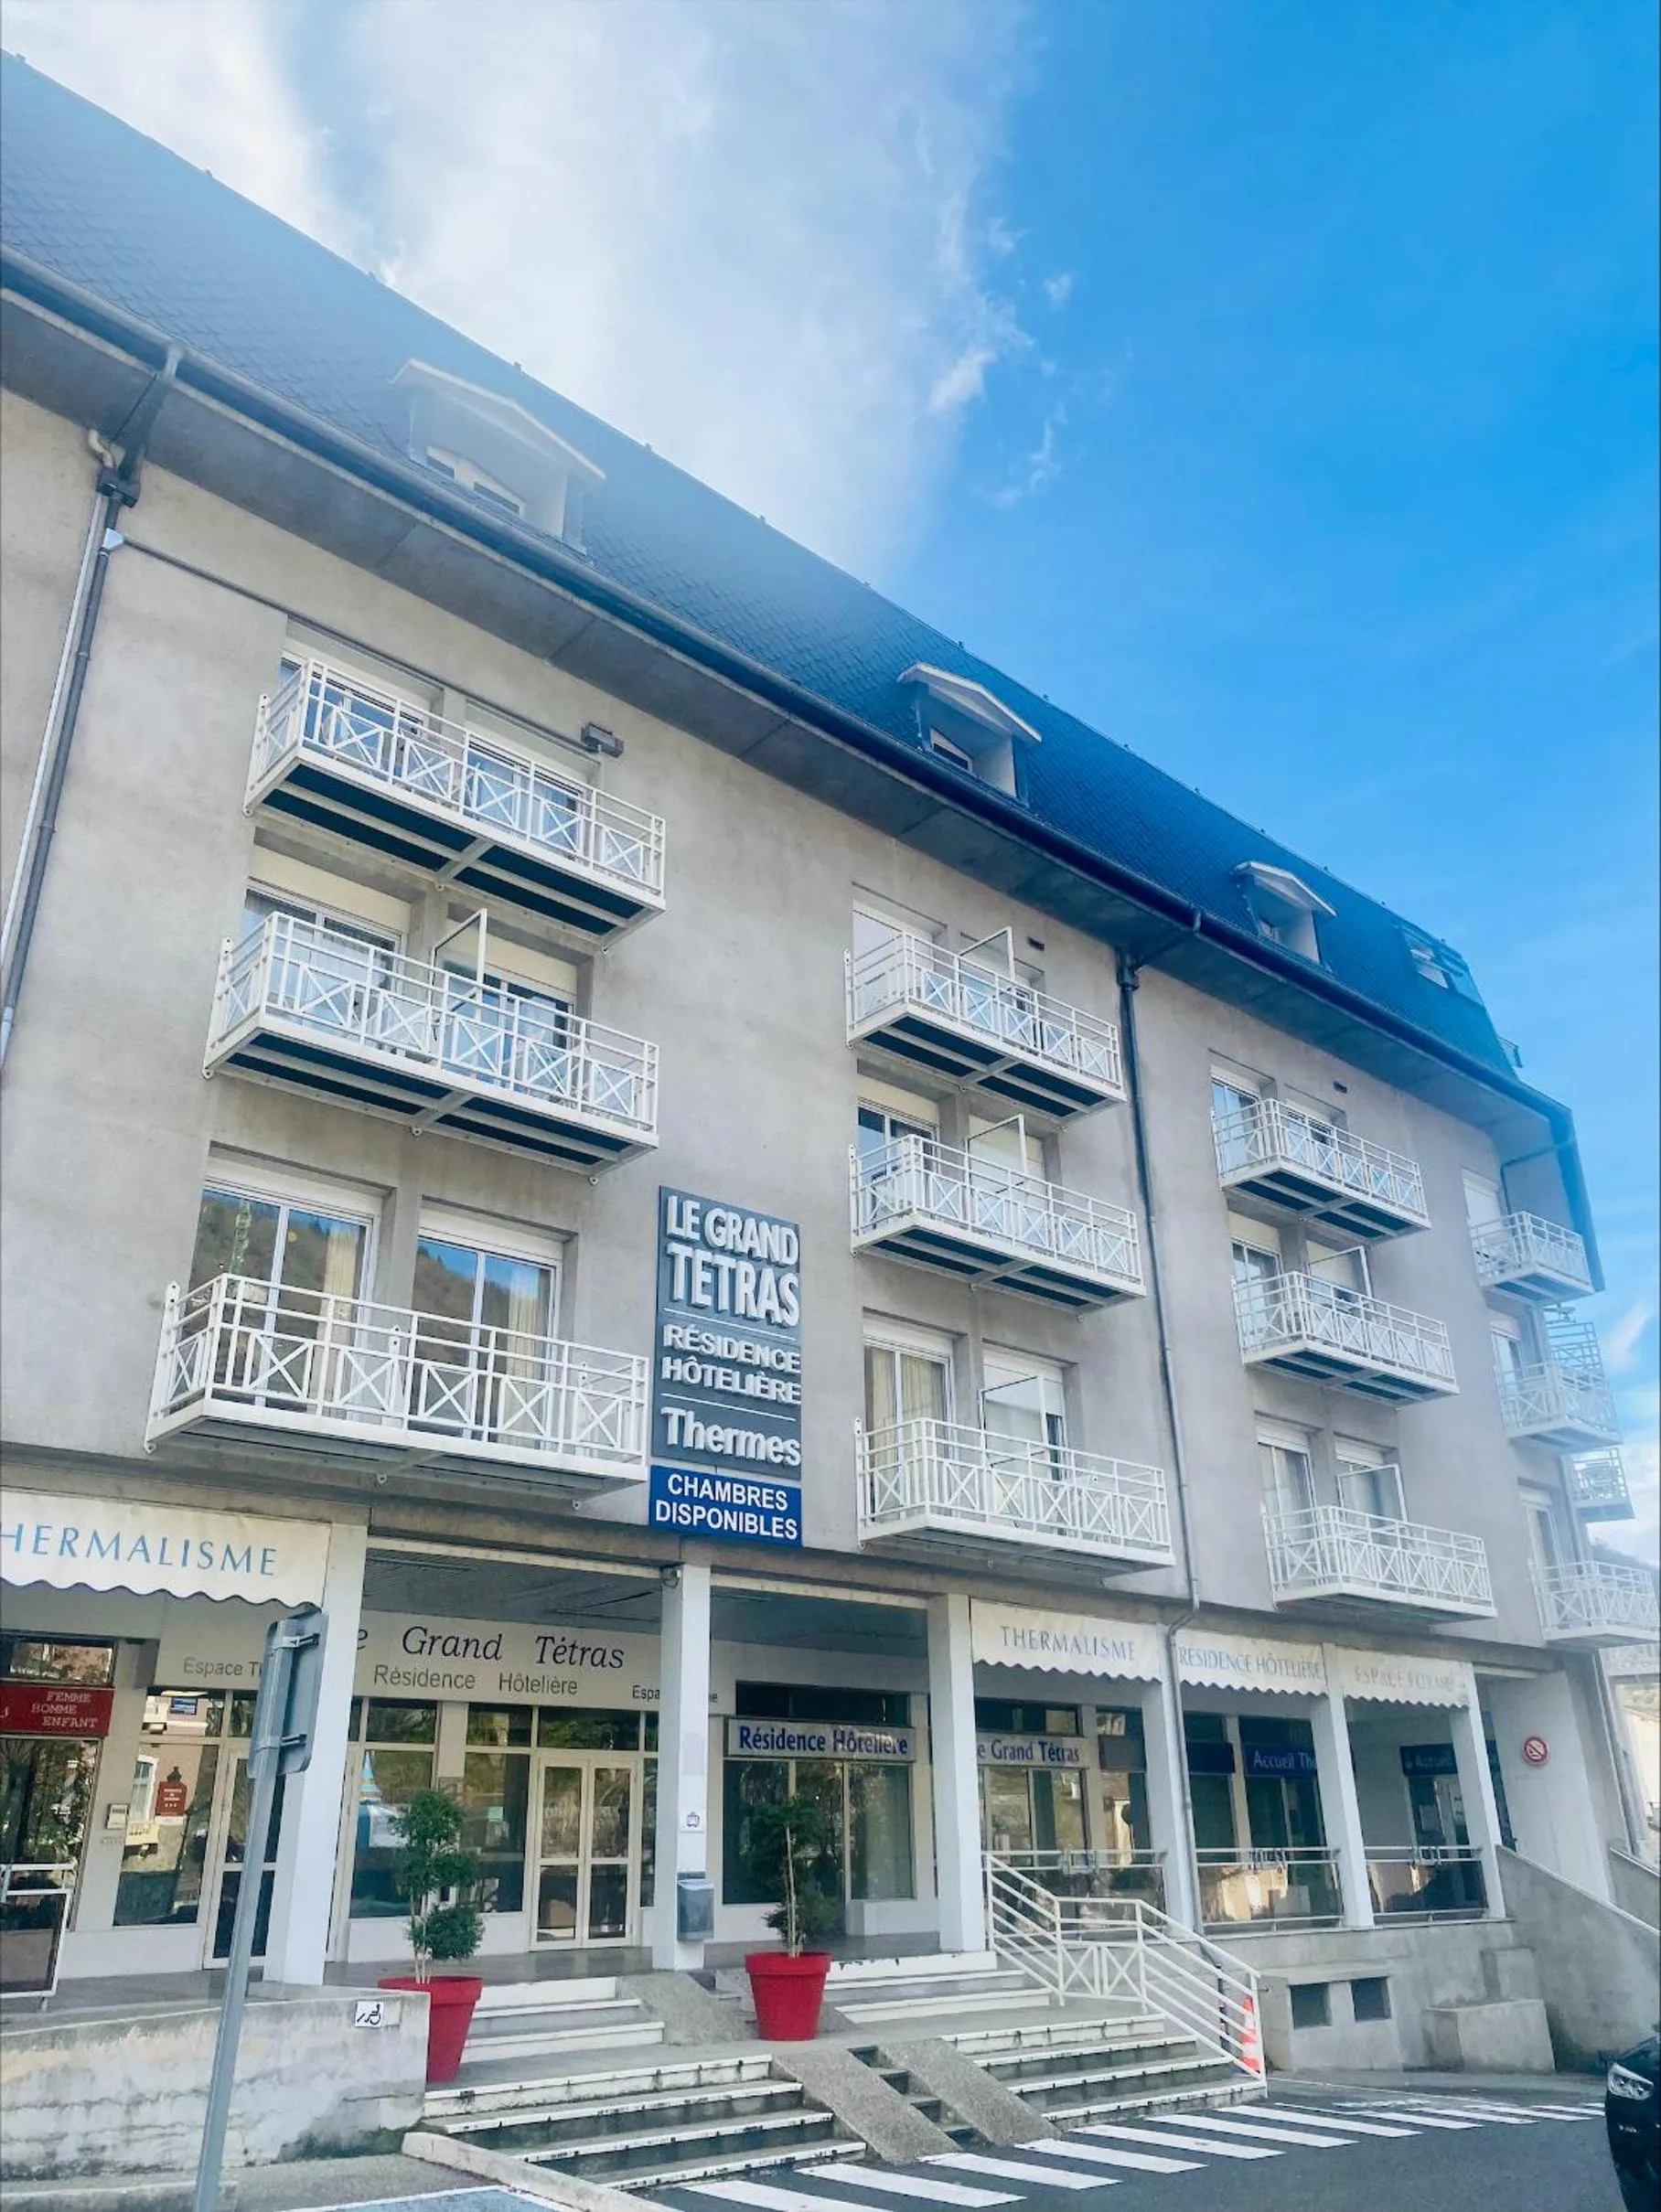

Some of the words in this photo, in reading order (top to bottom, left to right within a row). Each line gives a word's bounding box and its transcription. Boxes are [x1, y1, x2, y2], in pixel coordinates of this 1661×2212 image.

[666, 1195, 701, 1240] LE
[704, 1207, 799, 1266] GRAND
[667, 1242, 800, 1329] TETRAS
[662, 1322, 801, 1374] RÉSIDENCE
[660, 1354, 801, 1405] HÔTELIÈRE
[660, 1405, 801, 1468] Thermes
[666, 1473, 788, 1512] CHAMBRES
[655, 1500, 798, 1541] DISPONIBLES
[0, 1523, 278, 1577] HERMALISME
[358, 1629, 368, 1651] e
[402, 1625, 502, 1661] Grand
[535, 1635, 625, 1669] Tétras
[1001, 1626, 1137, 1662] THERMALISME
[183, 1656, 243, 1679] Espace
[373, 1664, 476, 1690] Résidence
[498, 1672, 579, 1695] Hôtelière
[31, 1703, 78, 1715] HOMME
[47, 1691, 91, 1703] FEMME
[632, 1685, 659, 1702] Espa
[42, 1715, 98, 1728] ENFANT
[738, 1726, 825, 1752] Résidence
[977, 1743, 986, 1758] e
[991, 1738, 1034, 1759] Grand
[1038, 1740, 1080, 1761] Tétras
[1253, 1749, 1295, 1769] Accueil
